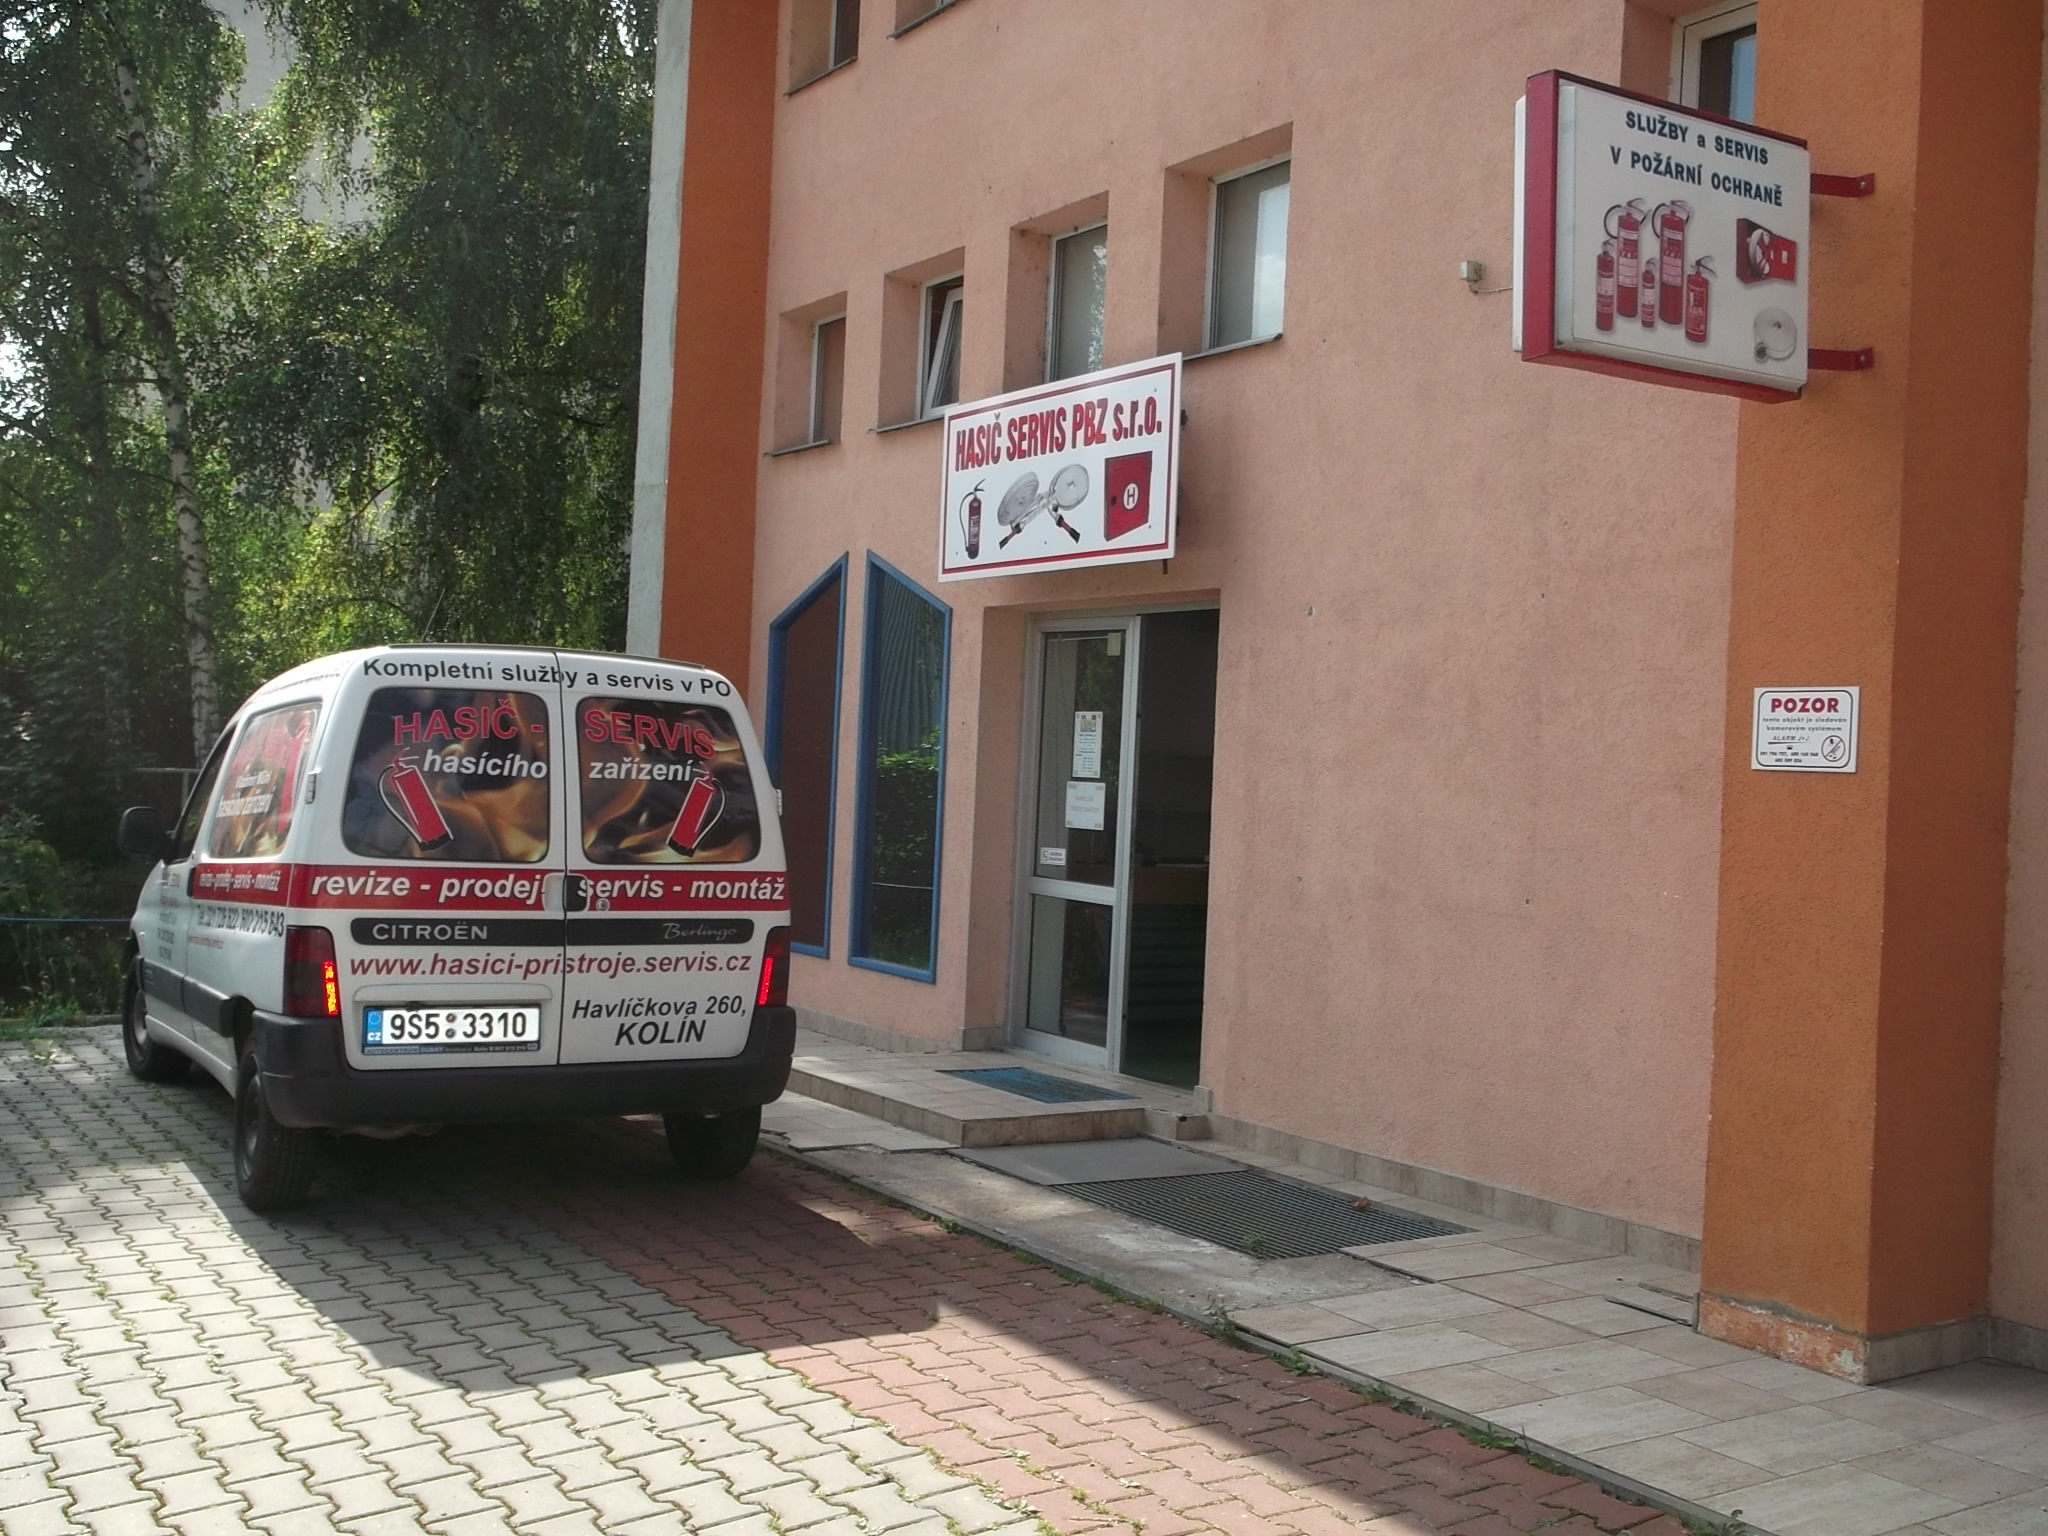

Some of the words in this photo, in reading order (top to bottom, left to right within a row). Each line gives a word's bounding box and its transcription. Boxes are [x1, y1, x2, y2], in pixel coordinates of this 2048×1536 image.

[1626, 110, 1689, 143] SLUŽBY
[1697, 134, 1706, 148] a
[1714, 135, 1768, 165] SERVIS
[1610, 145, 1621, 165] V
[1631, 151, 1703, 186] POŽÁRNÍ
[1711, 172, 1782, 207] OCHRANĚ
[955, 412, 1002, 472] HASIČ
[1006, 406, 1067, 461] SERVIS
[1071, 398, 1109, 449] PBZ
[1113, 396, 1162, 441] s.r.o.
[1127, 487, 1136, 506] H
[363, 658, 493, 682] Kompletní
[502, 664, 578, 688] služby
[586, 672, 599, 686] a
[607, 674, 674, 691] servis
[680, 680, 692, 693] v
[700, 678, 731, 697] PO
[1770, 697, 1840, 714] POZOR
[1782, 716, 1804, 724] objekt
[1806, 716, 1812, 724] je
[393, 699, 518, 746] HASIČ
[585, 708, 717, 760] SERVIS
[423, 748, 548, 779] hasícího
[588, 756, 693, 781] zařízení
[254, 870, 282, 892] montáž
[311, 870, 410, 897] revize
[438, 873, 541, 905] prodej
[577, 874, 664, 898] servis
[689, 876, 785, 900] montáž
[252, 909, 268, 934] 215
[268, 911, 285, 938] 643
[372, 921, 488, 940] CITROËN
[662, 922, 738, 942] Berlingo
[350, 951, 752, 980] www.hasici-pristroje.servis.cz
[571, 997, 697, 1020] Havlíčkova
[705, 995, 747, 1017] 260,
[367, 1032, 382, 1041] CZ
[390, 1012, 441, 1040] 9S5
[462, 1012, 527, 1039] 3310
[615, 1016, 707, 1046] KOLÍN
